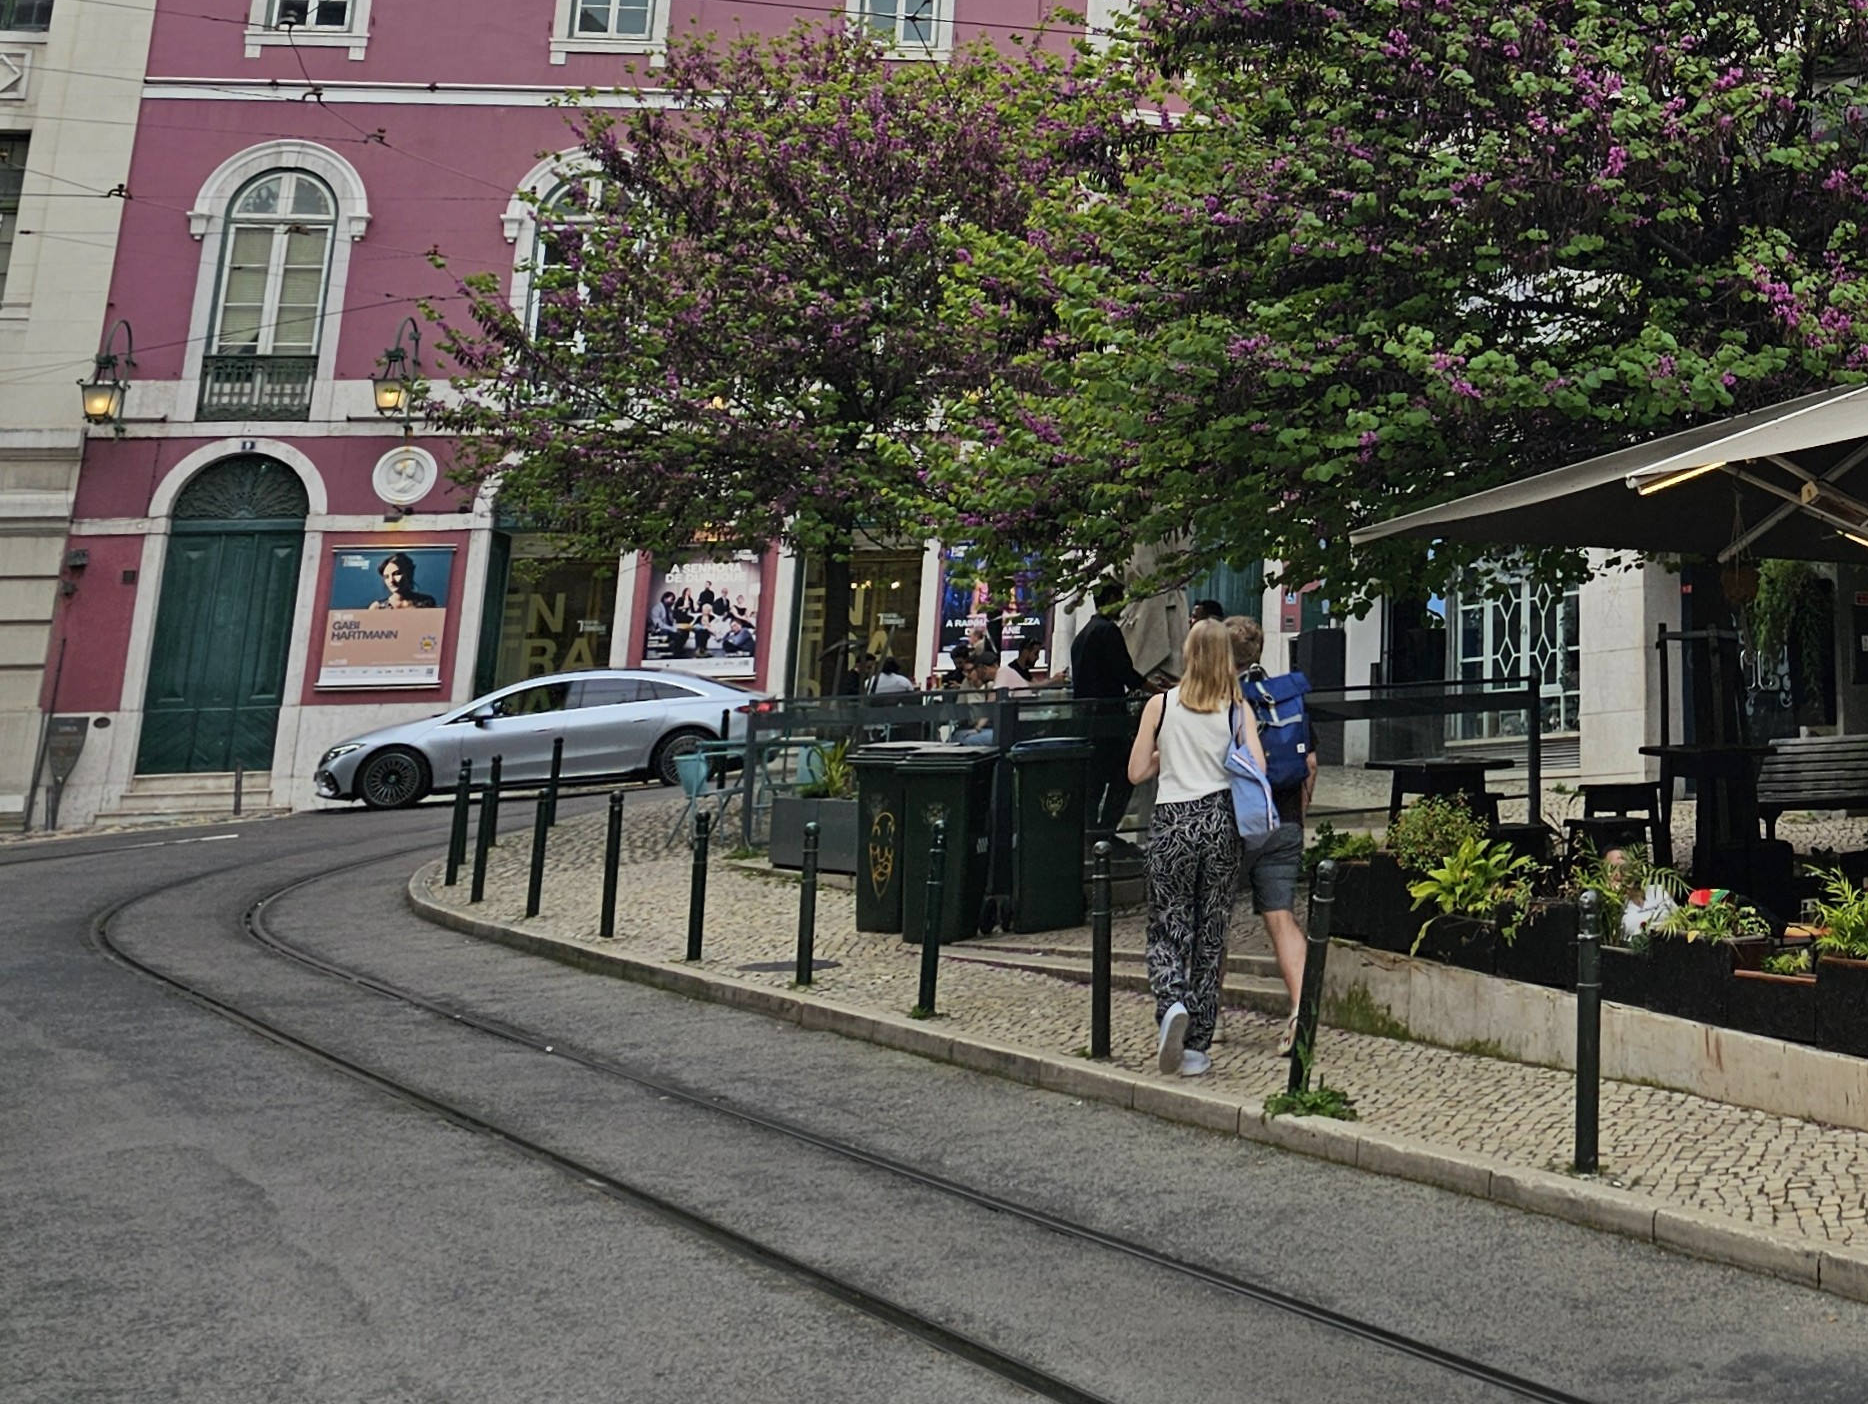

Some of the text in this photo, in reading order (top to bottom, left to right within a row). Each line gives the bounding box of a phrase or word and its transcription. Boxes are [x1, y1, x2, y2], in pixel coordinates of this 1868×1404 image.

[682, 563, 743, 574] SENHORA
[332, 621, 361, 631] GABI
[331, 630, 399, 641] HARTMANN
